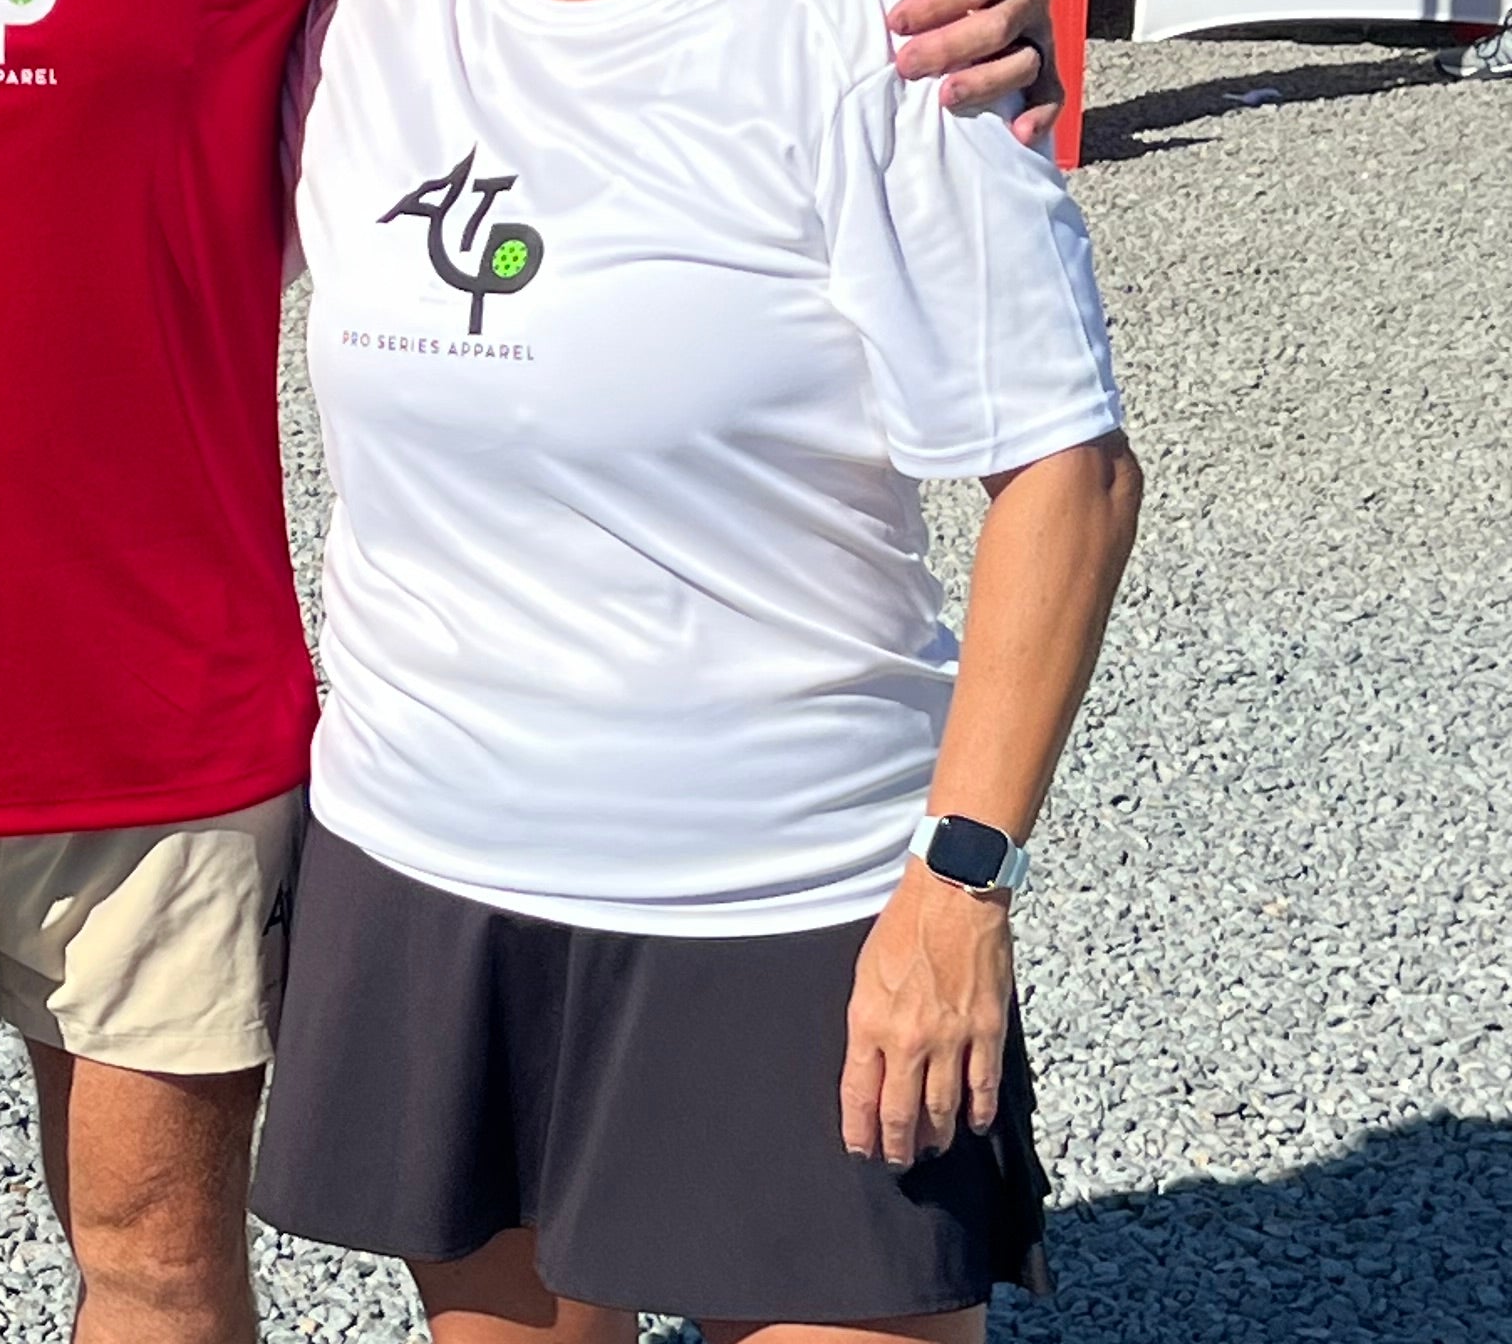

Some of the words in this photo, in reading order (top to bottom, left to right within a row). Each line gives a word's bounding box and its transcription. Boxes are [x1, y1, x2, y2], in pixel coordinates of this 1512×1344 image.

[376, 141, 545, 335] ATP
[342, 330, 371, 347] PRO
[377, 335, 440, 354] SERIES
[448, 342, 535, 361] APPAREL
